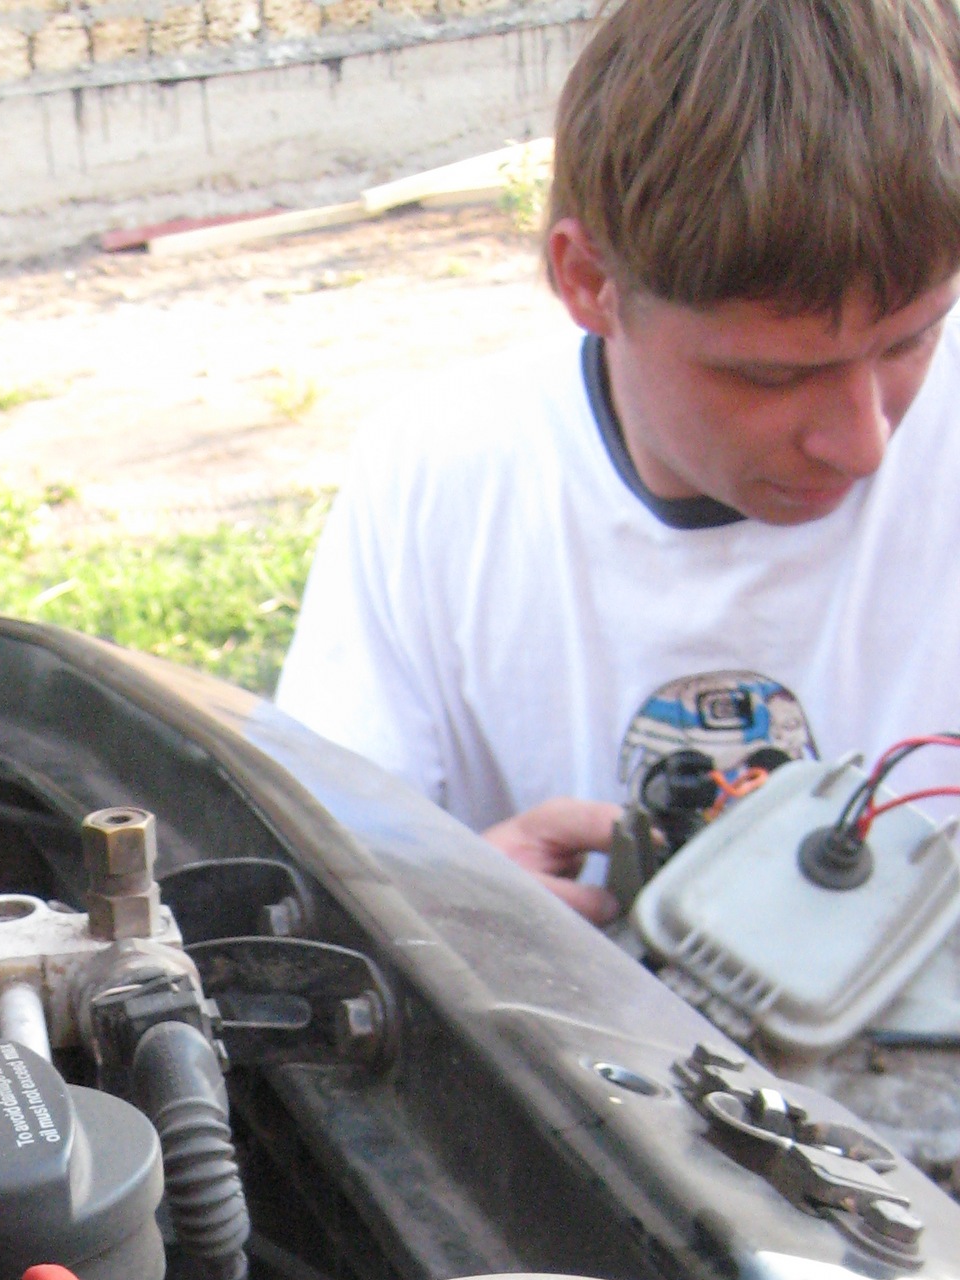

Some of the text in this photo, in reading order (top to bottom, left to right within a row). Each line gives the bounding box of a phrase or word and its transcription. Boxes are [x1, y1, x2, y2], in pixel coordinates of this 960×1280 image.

[6, 1060, 36, 1089] exceed
[21, 1088, 43, 1105] not
[3, 1106, 30, 1132] avoid
[29, 1104, 55, 1129] must
[16, 1132, 35, 1148] To
[39, 1129, 60, 1142] oil
